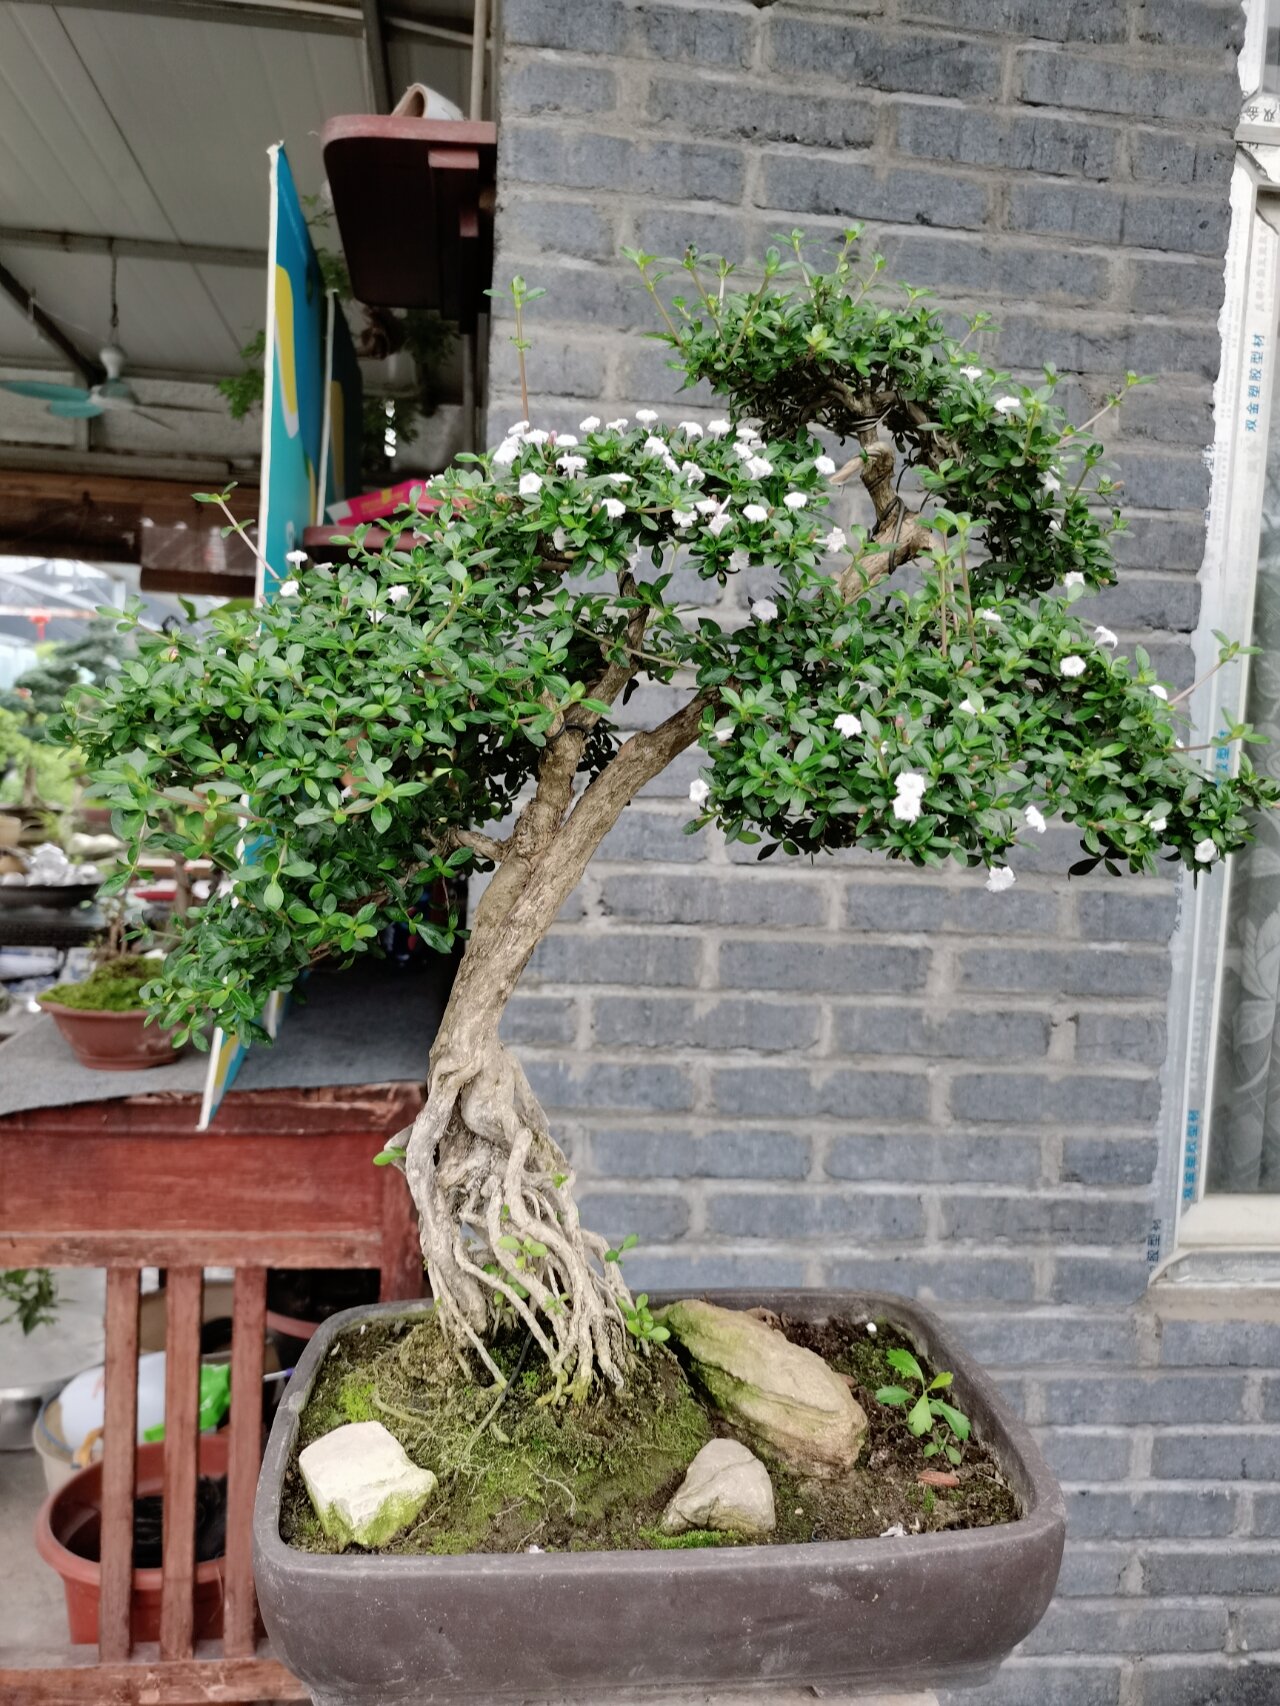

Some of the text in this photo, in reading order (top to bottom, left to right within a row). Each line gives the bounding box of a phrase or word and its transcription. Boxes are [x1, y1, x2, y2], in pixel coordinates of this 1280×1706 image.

[1245, 334, 1265, 432] 双金塑胶型材
